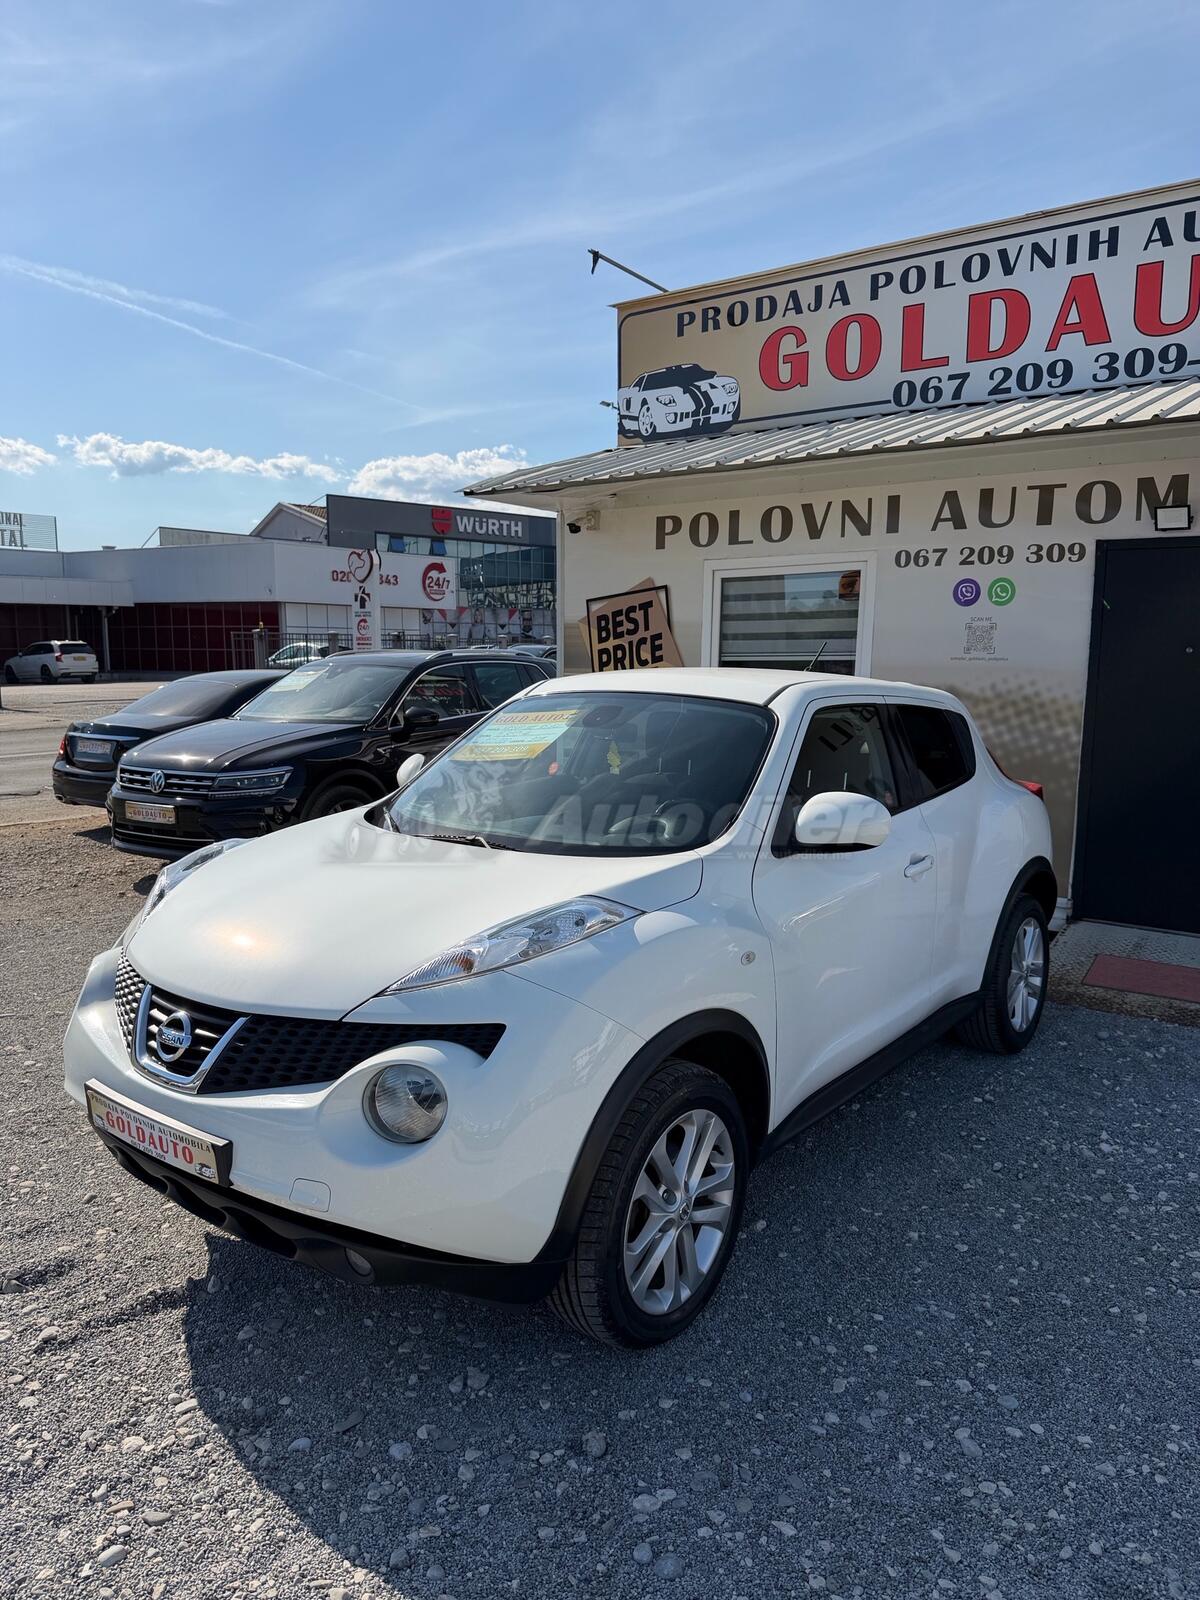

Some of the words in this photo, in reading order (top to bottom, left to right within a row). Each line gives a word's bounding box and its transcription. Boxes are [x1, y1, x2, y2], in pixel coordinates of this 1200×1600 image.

[676, 280, 851, 338] PRODAJA
[869, 225, 1120, 301] POLOVNIH
[758, 252, 1200, 392] GOLDAU
[892, 371, 971, 408] 067
[987, 358, 1074, 397] 209
[1091, 342, 1188, 383] 309
[455, 515, 523, 538] WÜRTH
[655, 494, 901, 550] POLOVNI
[930, 473, 1190, 532] AUTOM
[894, 547, 949, 569] 067
[958, 544, 1015, 566] 209
[1025, 542, 1087, 564] 309
[427, 575, 451, 590] 24/7
[596, 599, 654, 645] BEST
[597, 631, 664, 673] PRICE
[105, 1110, 194, 1165] GOLDAUTO
[120, 1110, 156, 1132] POLOVNIH
[157, 1127, 211, 1153] AUTOMOBILA
